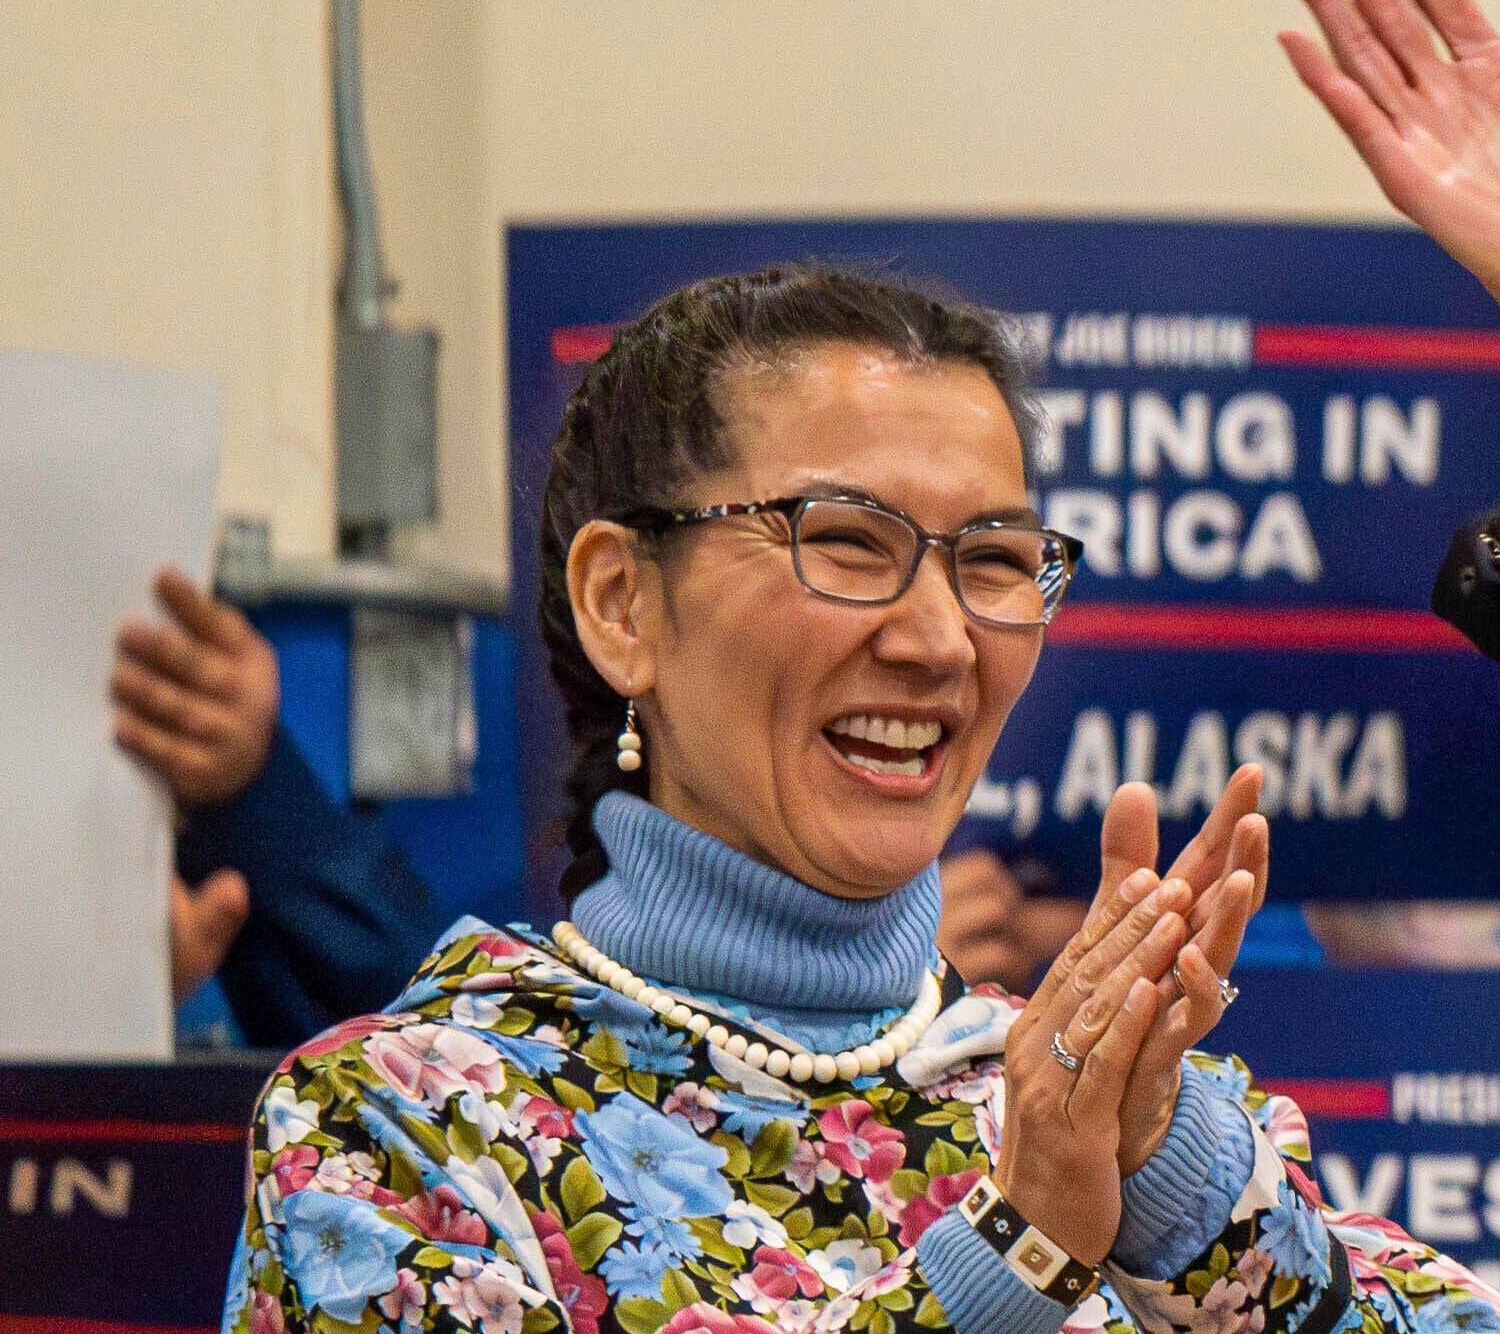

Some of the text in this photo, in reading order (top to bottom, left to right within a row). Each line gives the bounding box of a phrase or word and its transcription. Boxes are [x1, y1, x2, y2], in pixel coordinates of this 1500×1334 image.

[1322, 395, 1441, 486] IN
[1052, 709, 1408, 823] ALASKA
[8, 1158, 133, 1217] IN
